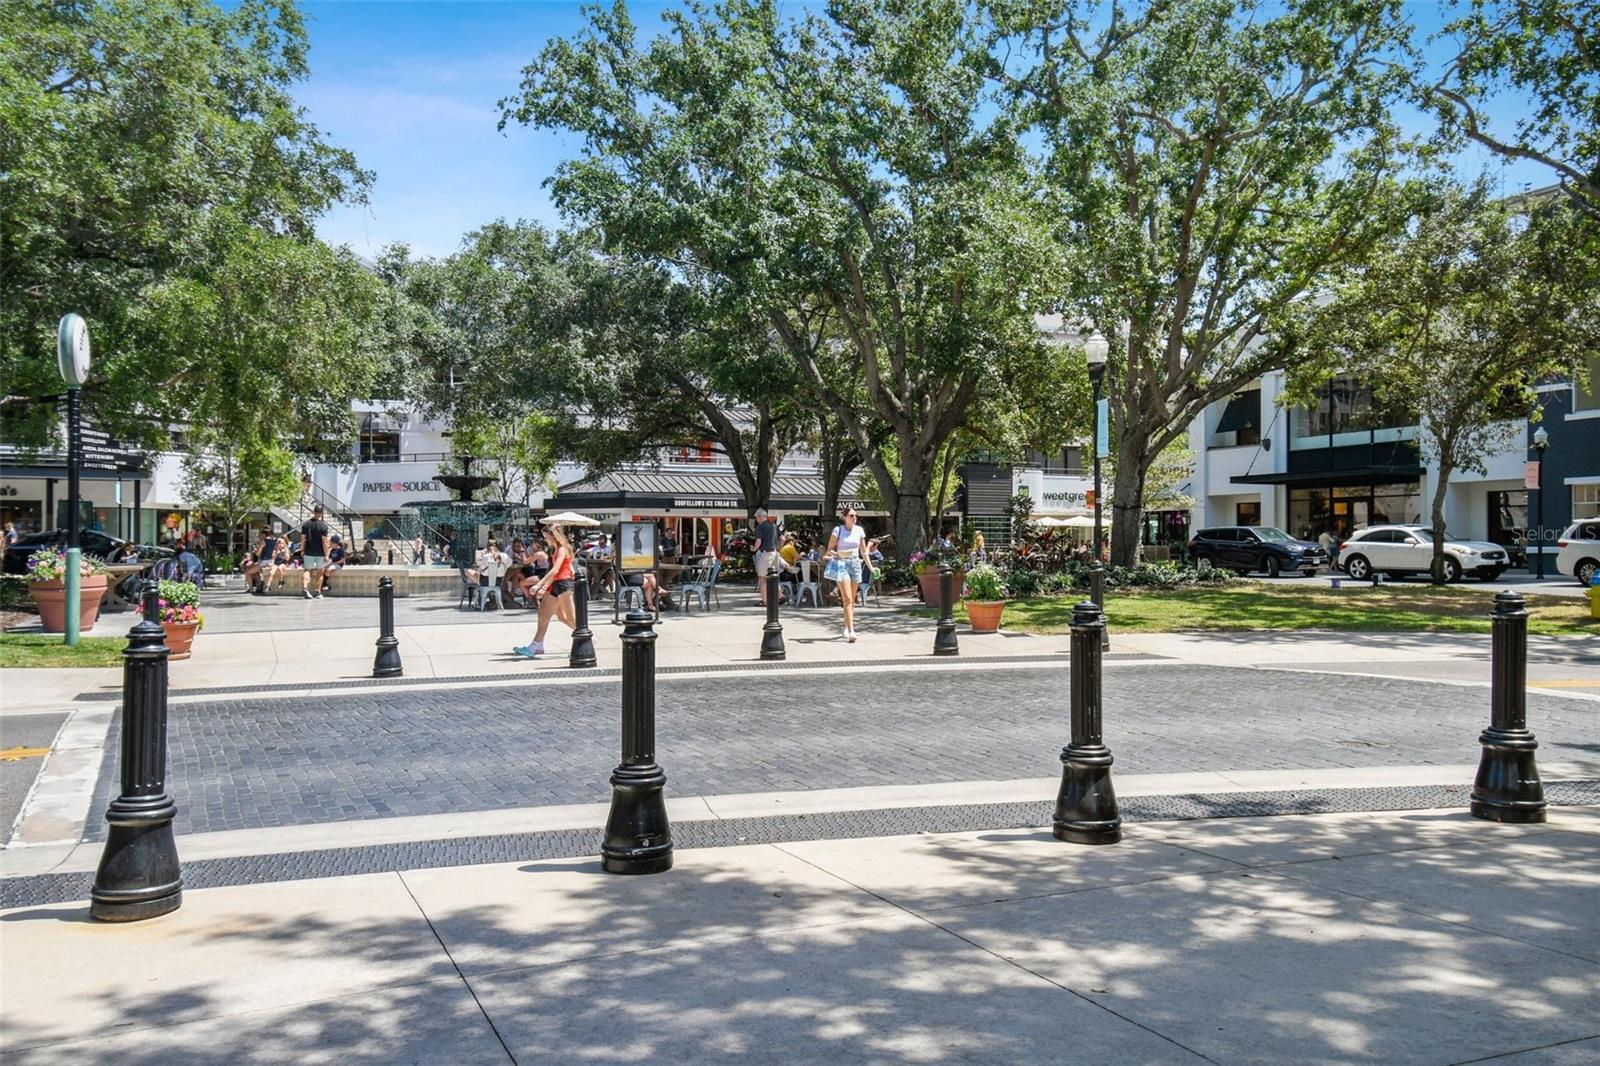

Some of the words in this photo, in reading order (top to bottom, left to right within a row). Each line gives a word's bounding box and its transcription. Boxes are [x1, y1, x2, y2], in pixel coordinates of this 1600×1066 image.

[362, 482, 392, 493] PAPER
[402, 482, 440, 492] SOURCE
[1043, 491, 1084, 502] weetgre
[714, 500, 730, 508] CREAM
[836, 502, 865, 510] AVEDA
